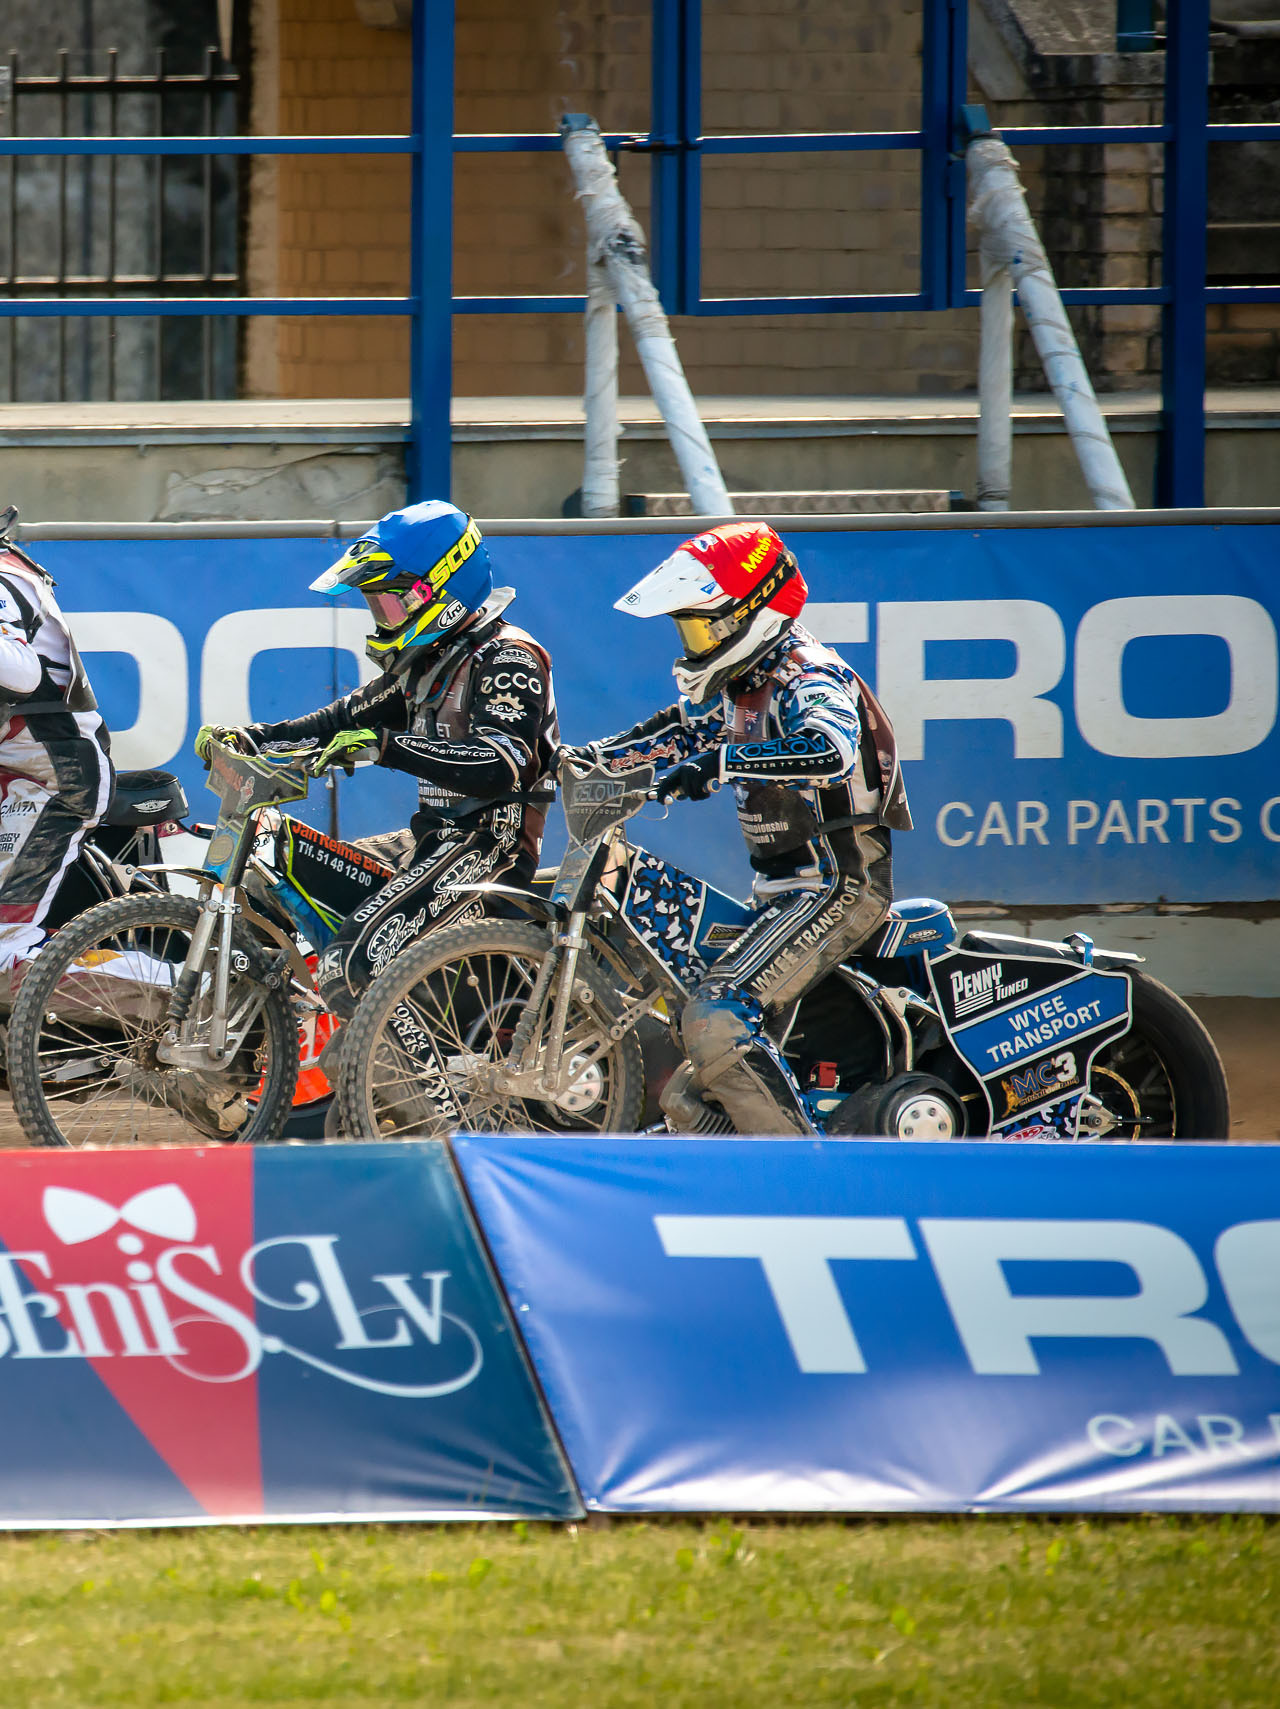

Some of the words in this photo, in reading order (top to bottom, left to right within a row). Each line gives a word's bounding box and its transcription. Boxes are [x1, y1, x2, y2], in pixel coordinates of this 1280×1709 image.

[740, 537, 772, 573] Mitch
[351, 683, 402, 717] WULFSPOR
[292, 821, 317, 843] Jan
[936, 800, 1056, 848] CAR
[1067, 797, 1241, 846] PARTS
[316, 850, 329, 865] 51
[330, 858, 344, 873] 48
[345, 865, 357, 880] 12
[359, 871, 372, 887] 00
[793, 874, 861, 951] TRANSPORT
[986, 1000, 1102, 1063] TRANSPORT
[1008, 995, 1067, 1032] WYEE
[654, 1215, 1280, 1377] TR
[1087, 1414, 1257, 1458] CAR
